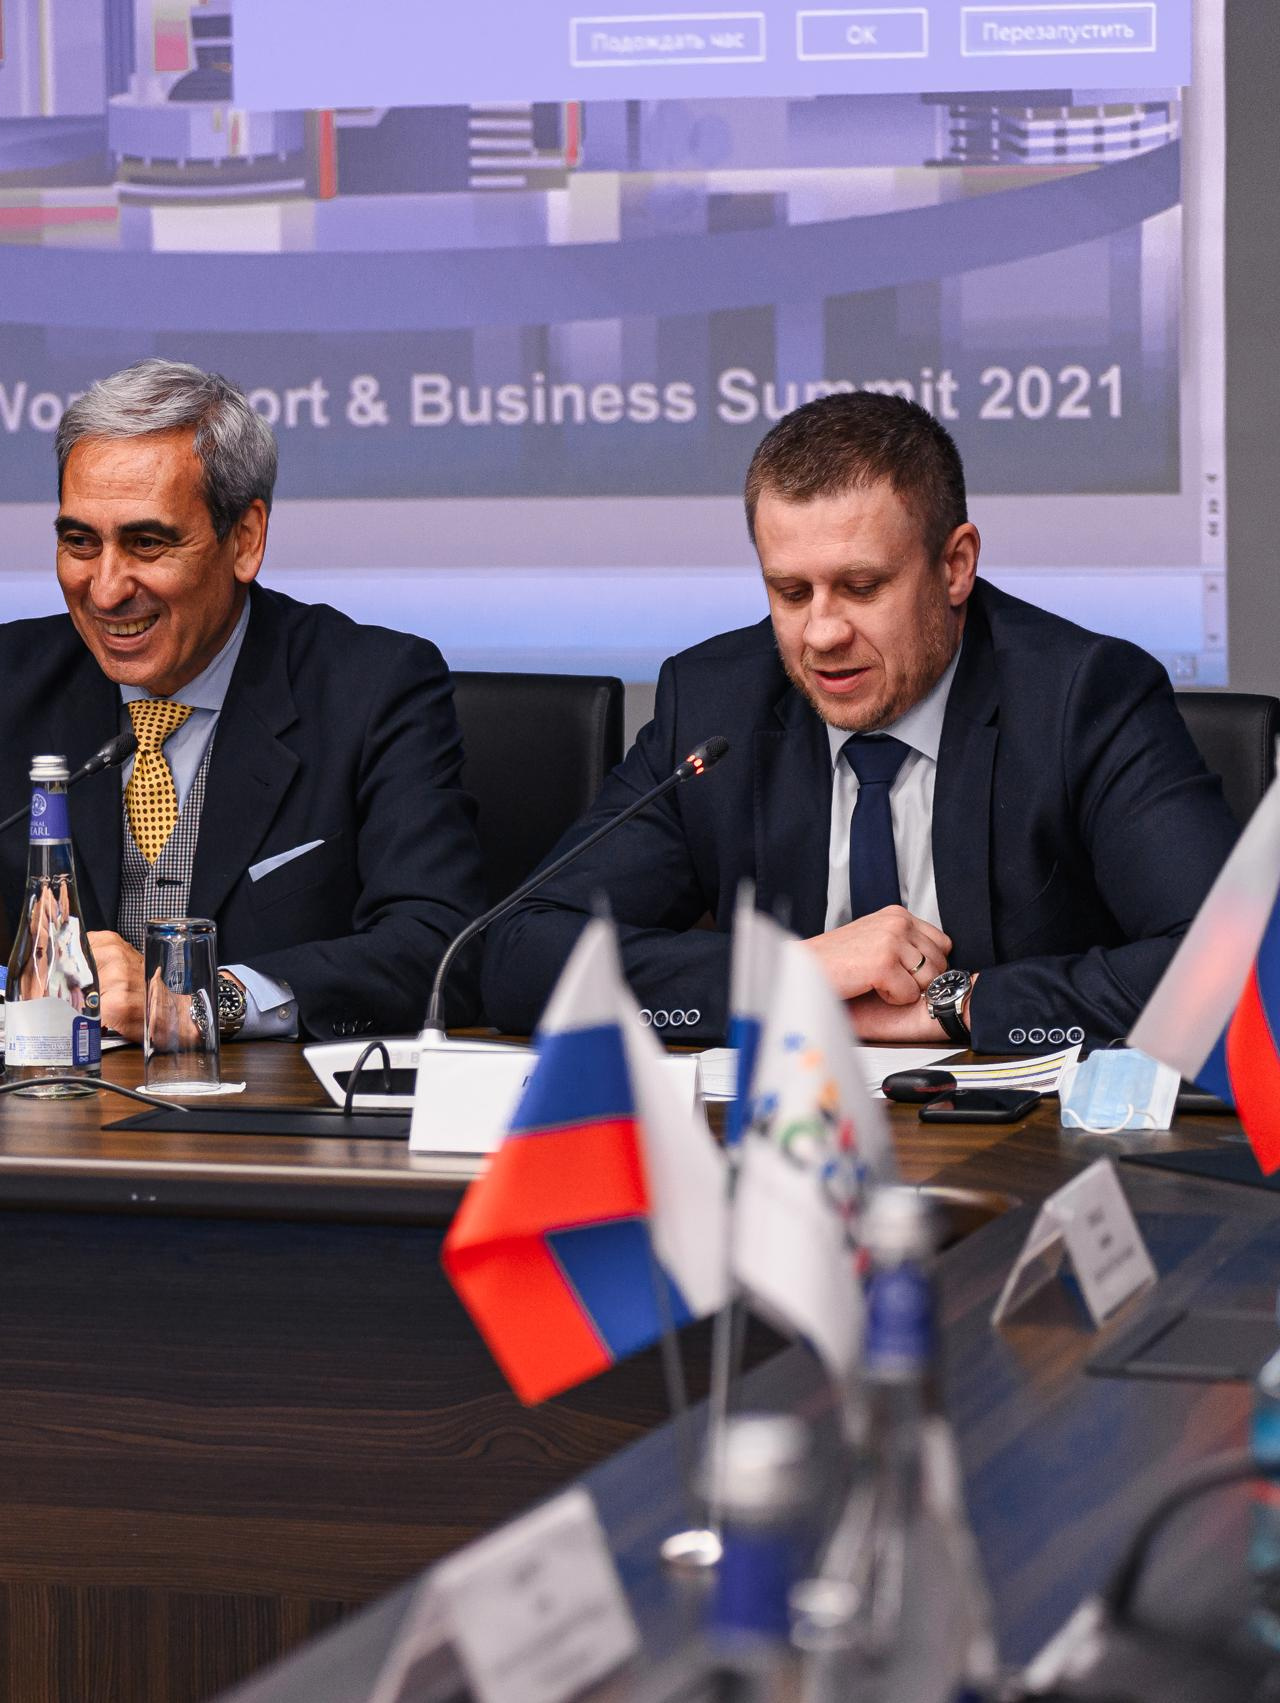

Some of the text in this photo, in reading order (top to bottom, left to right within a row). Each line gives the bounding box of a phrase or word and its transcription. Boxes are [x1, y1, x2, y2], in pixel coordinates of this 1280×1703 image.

[982, 18, 1136, 43] Перезапустить
[246, 377, 330, 428] ort
[346, 374, 389, 426] &
[410, 372, 697, 426] Business
[978, 364, 1122, 419] 2021
